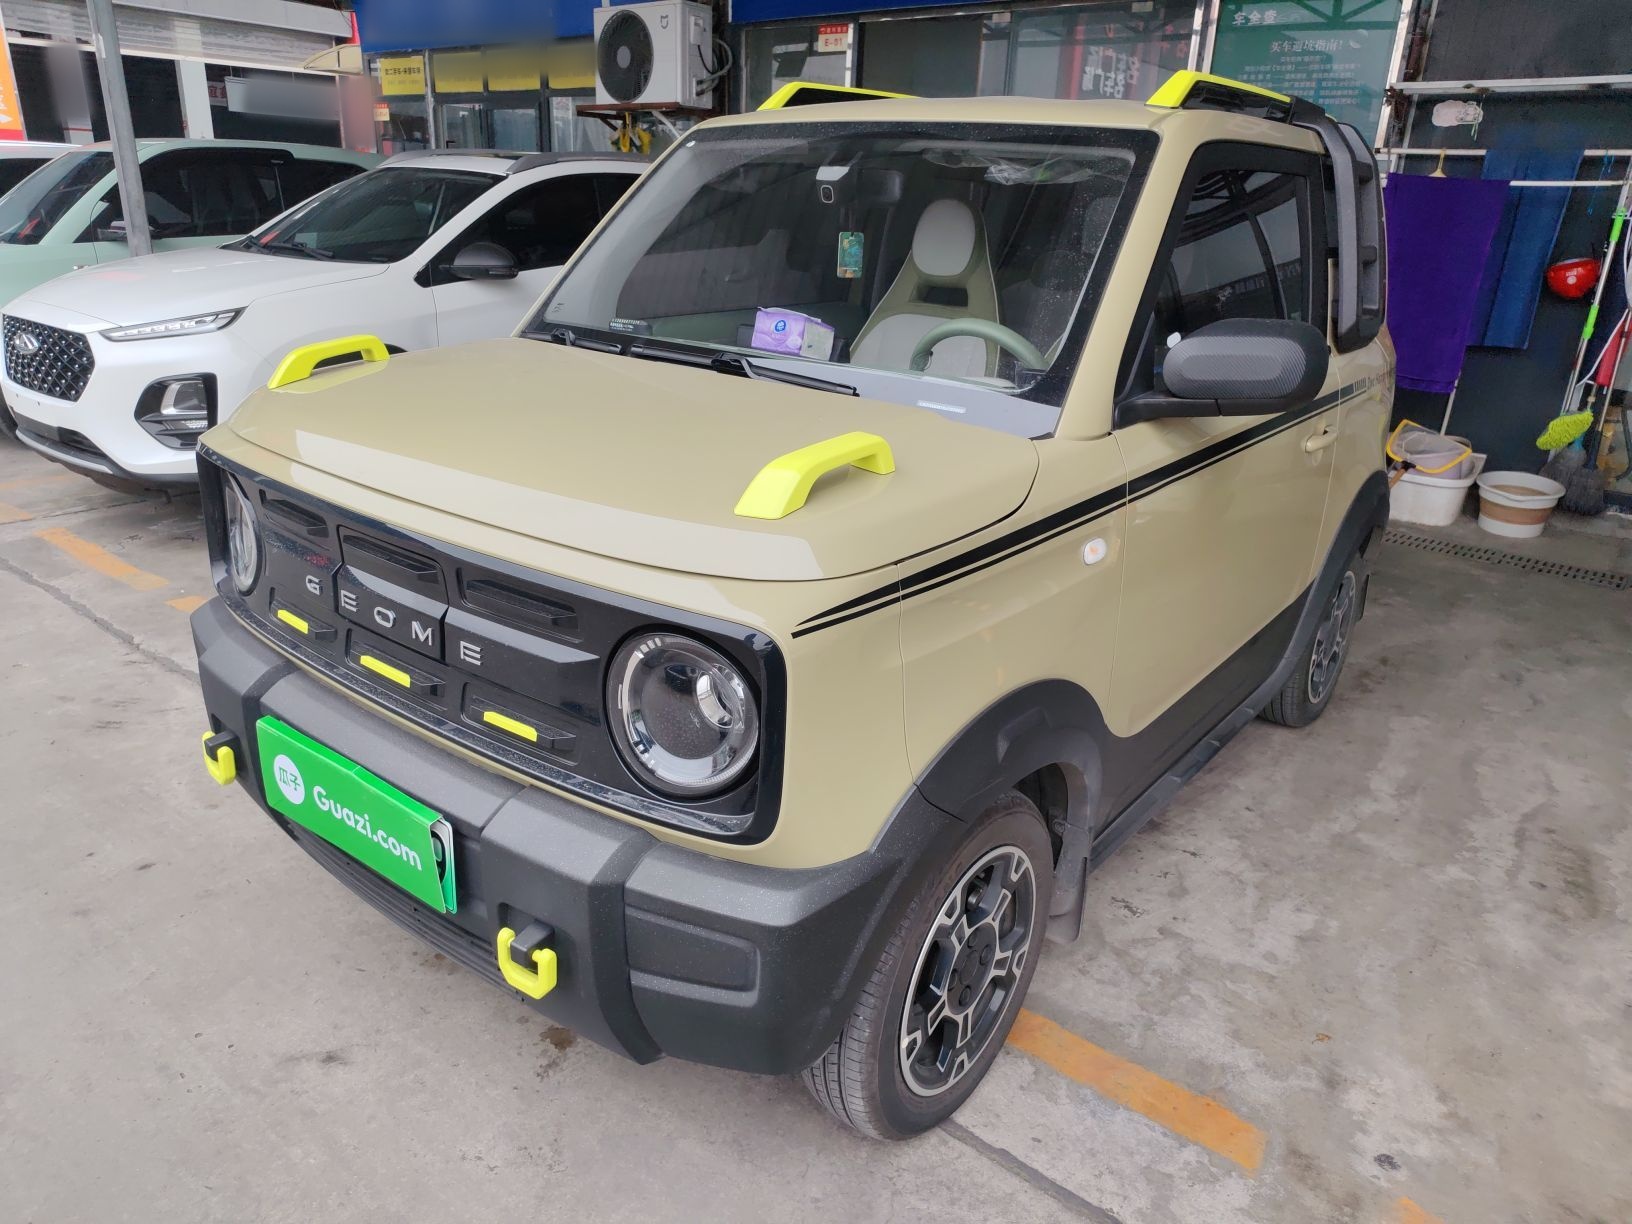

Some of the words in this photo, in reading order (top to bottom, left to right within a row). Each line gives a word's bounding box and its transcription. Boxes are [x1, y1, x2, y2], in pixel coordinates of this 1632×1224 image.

[305, 574, 482, 666] GEOME
[278, 766, 301, 792] 瓜子
[313, 785, 423, 872] Guazi.com
